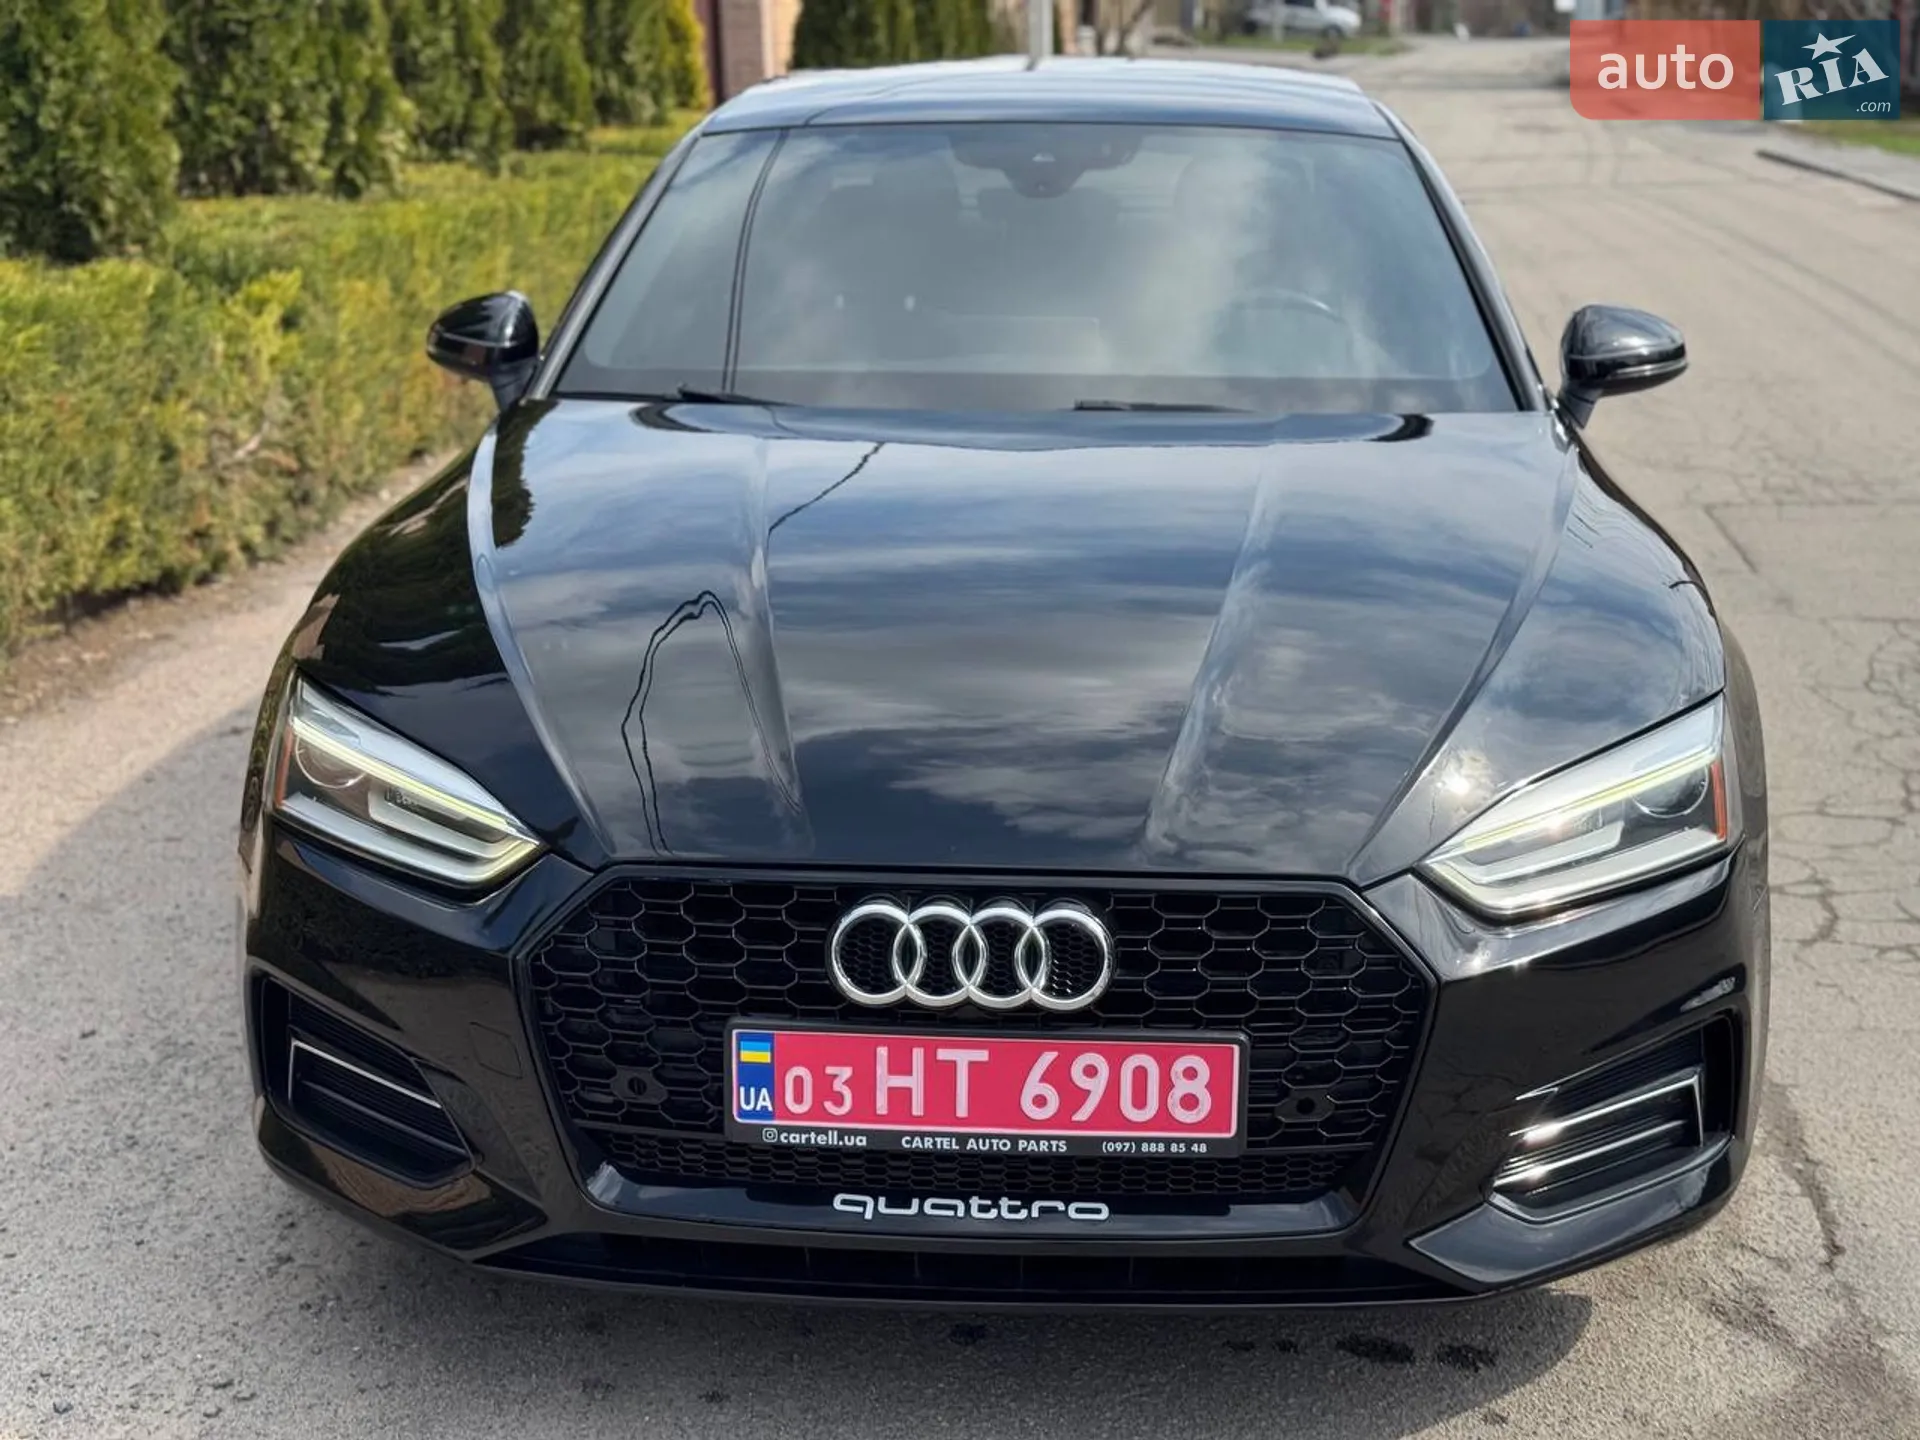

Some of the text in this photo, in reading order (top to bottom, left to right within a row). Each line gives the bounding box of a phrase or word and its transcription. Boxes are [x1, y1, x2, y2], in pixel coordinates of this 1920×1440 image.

[784, 1046, 1212, 1124] 03 HT 6908
[739, 1086, 774, 1112] UA
[780, 1130, 867, 1147] cartell.ua
[901, 1136, 1068, 1152] CARTEL AUTO PARTS
[1102, 1141, 1207, 1153] (097) 888 85 48
[832, 1193, 1110, 1220] quattro
